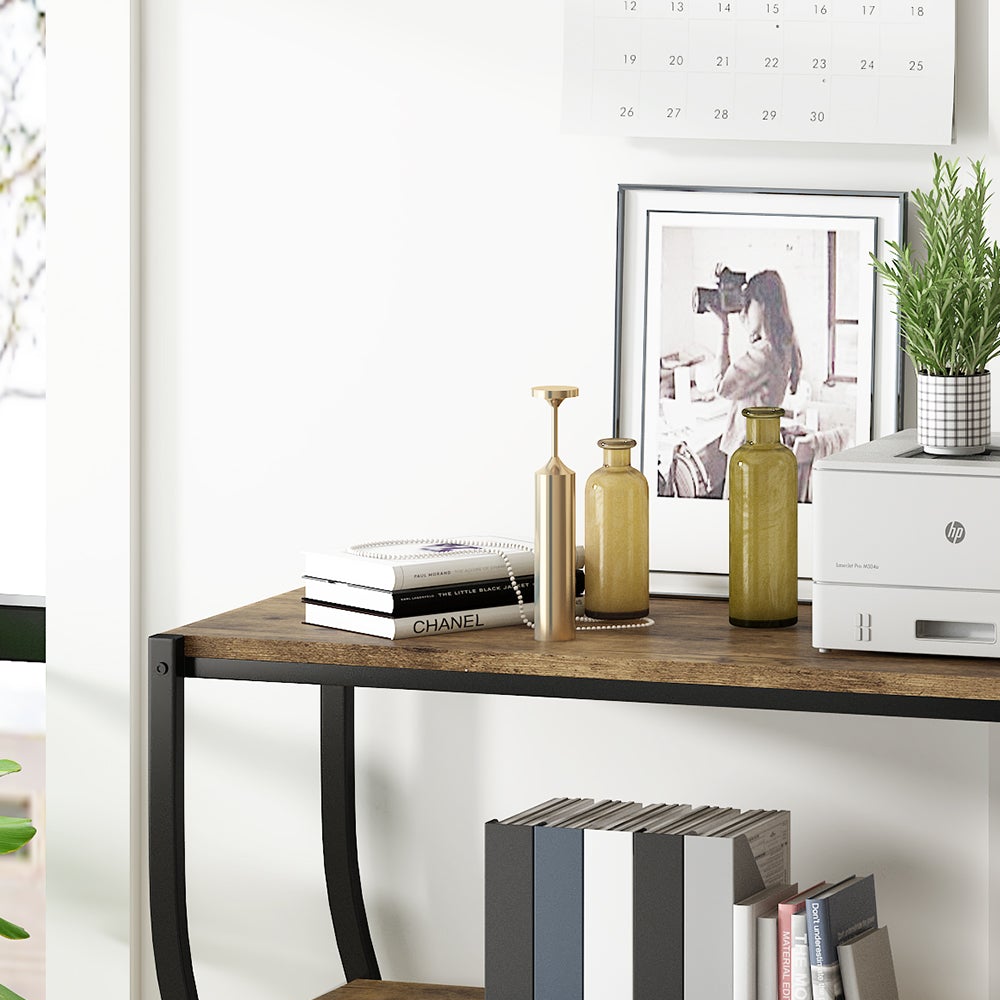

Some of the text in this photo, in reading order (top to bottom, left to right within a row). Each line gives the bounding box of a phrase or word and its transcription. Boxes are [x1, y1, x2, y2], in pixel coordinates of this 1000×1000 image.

[623, 1, 924, 17] 12 13 14 15 16 17 18
[623, 54, 923, 71] 19 20 21 22 23 24 25
[620, 106, 824, 122] 26 27 28 29 30
[946, 520, 965, 544] hp
[454, 588, 476, 596] LITTLE
[413, 614, 484, 634] CHANEL
[812, 902, 820, 923] Don't
[782, 931, 790, 979] MATERIAL
[795, 933, 808, 963] THE
